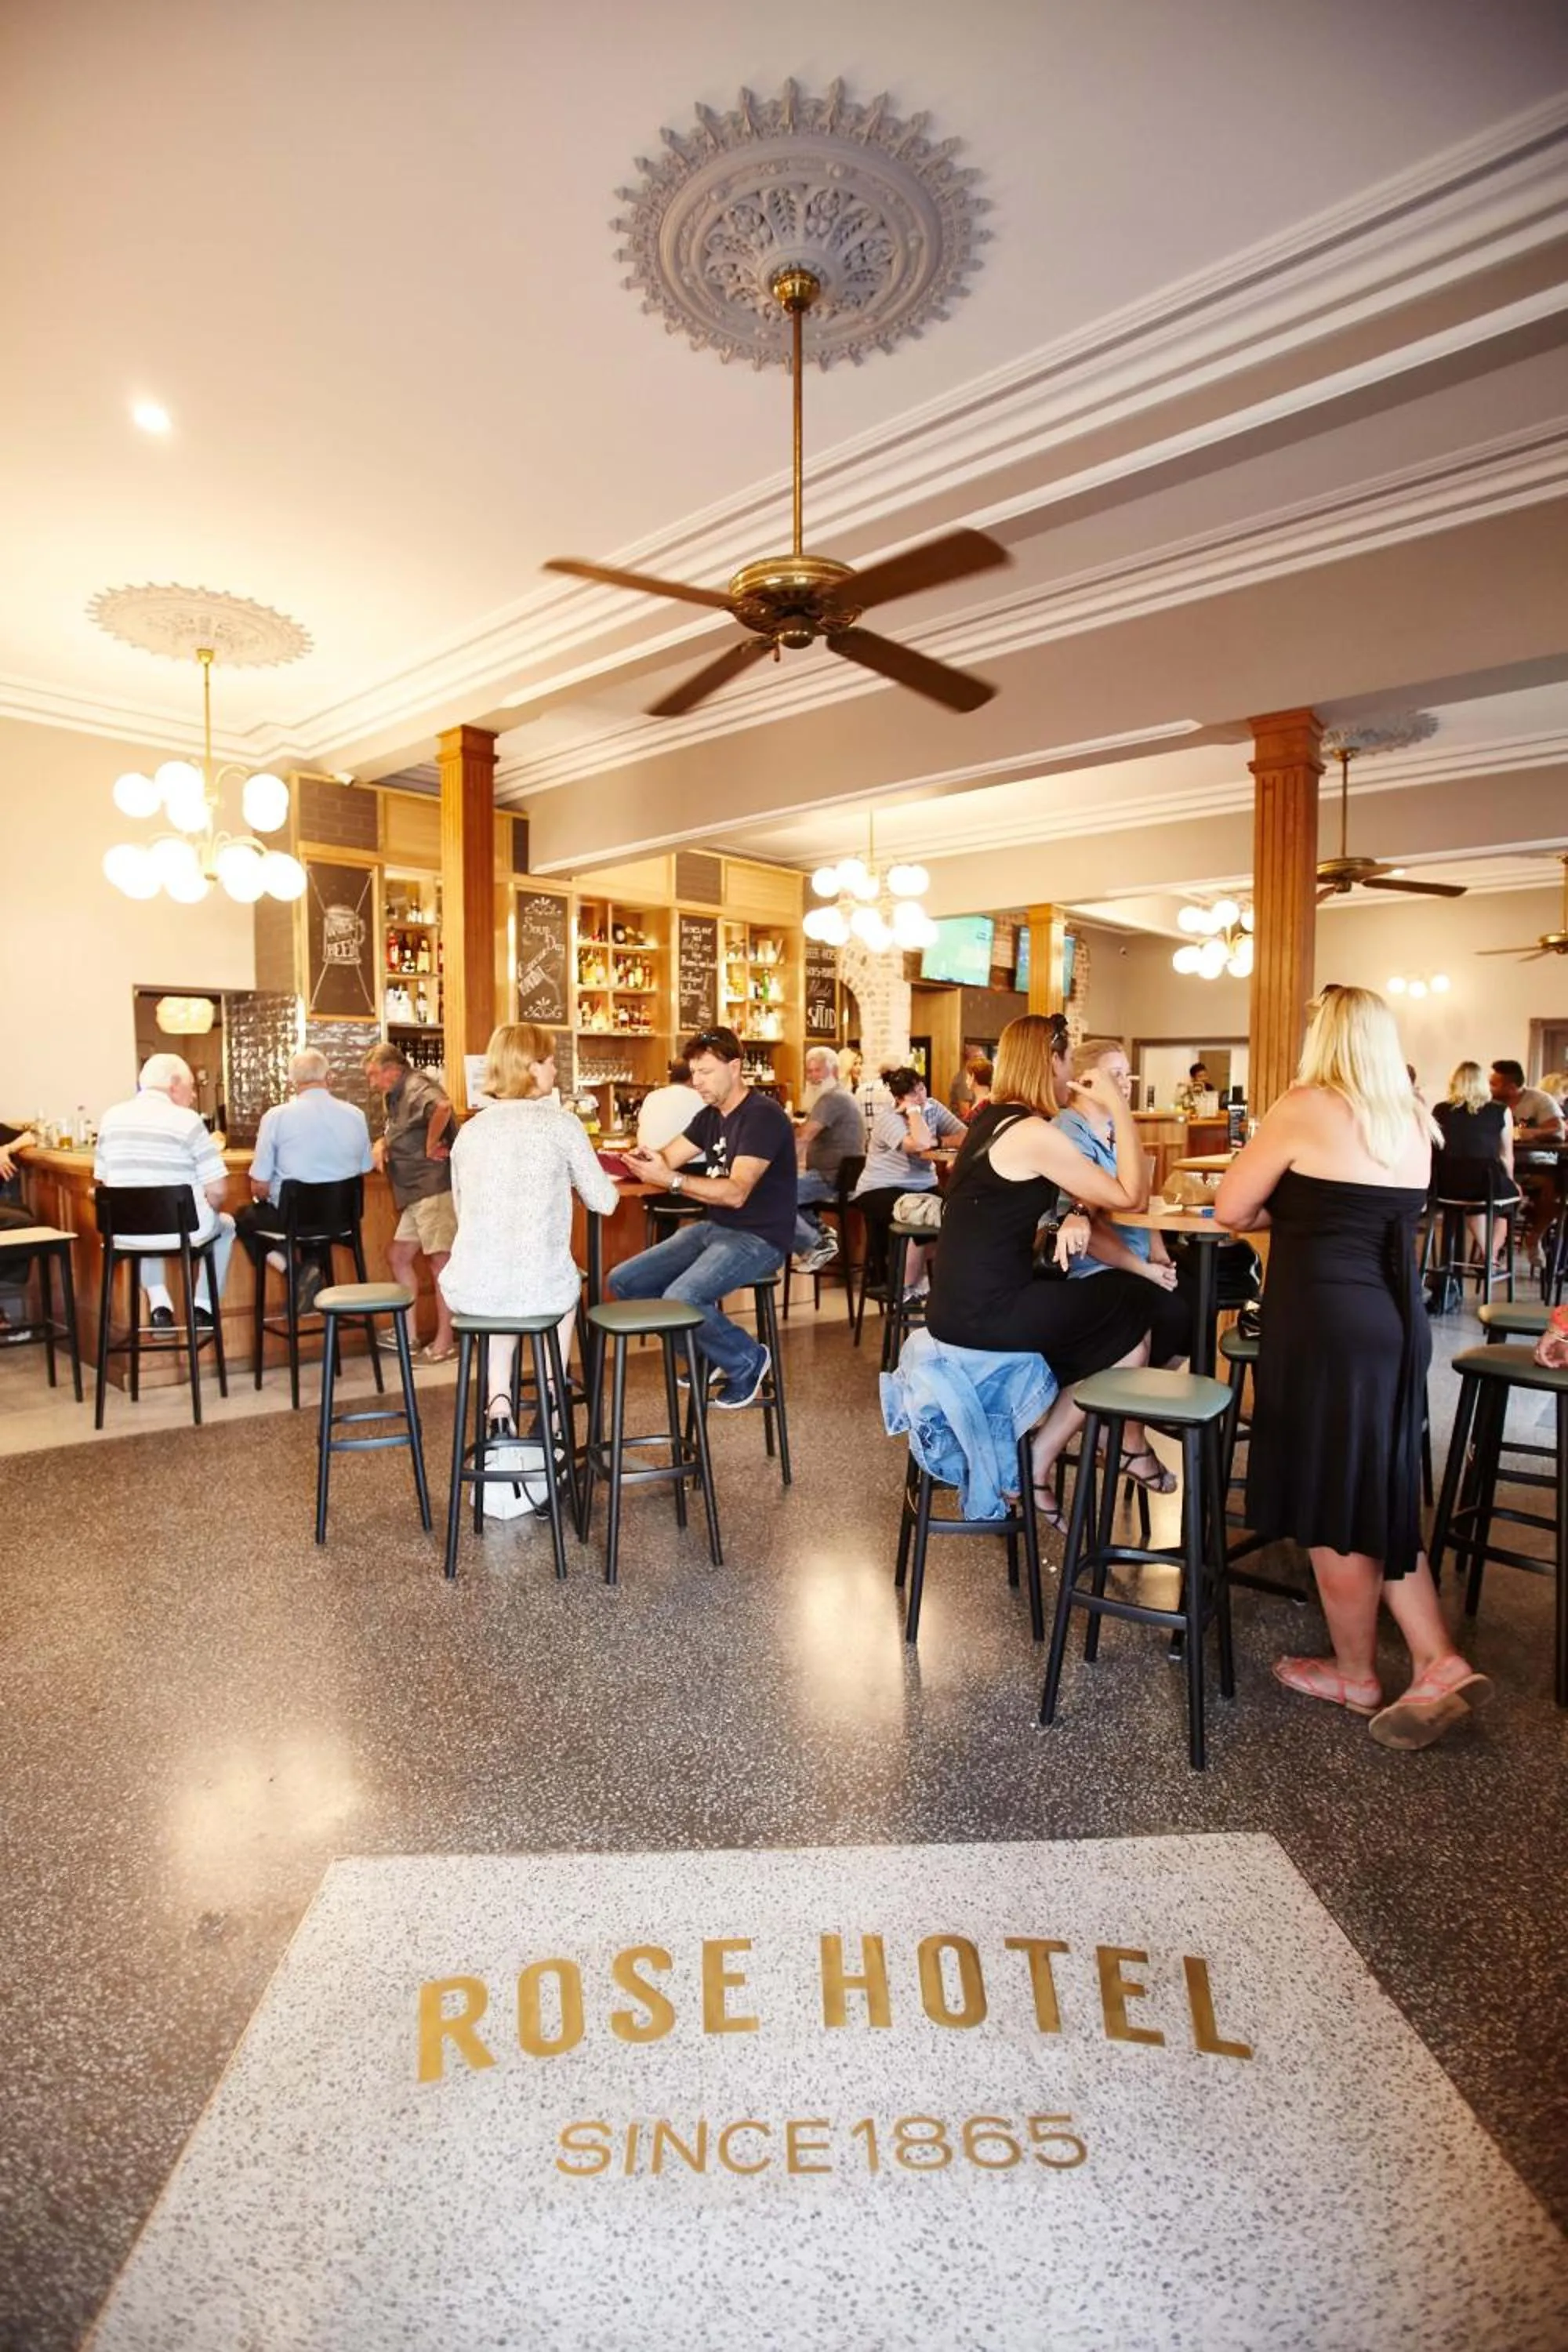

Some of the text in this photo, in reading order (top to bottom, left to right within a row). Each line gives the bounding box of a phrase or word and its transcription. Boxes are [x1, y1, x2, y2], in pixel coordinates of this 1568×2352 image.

[418, 1935, 1254, 2082] ROSE HOTEL
[555, 2114, 1088, 2176] SINCE 1865
